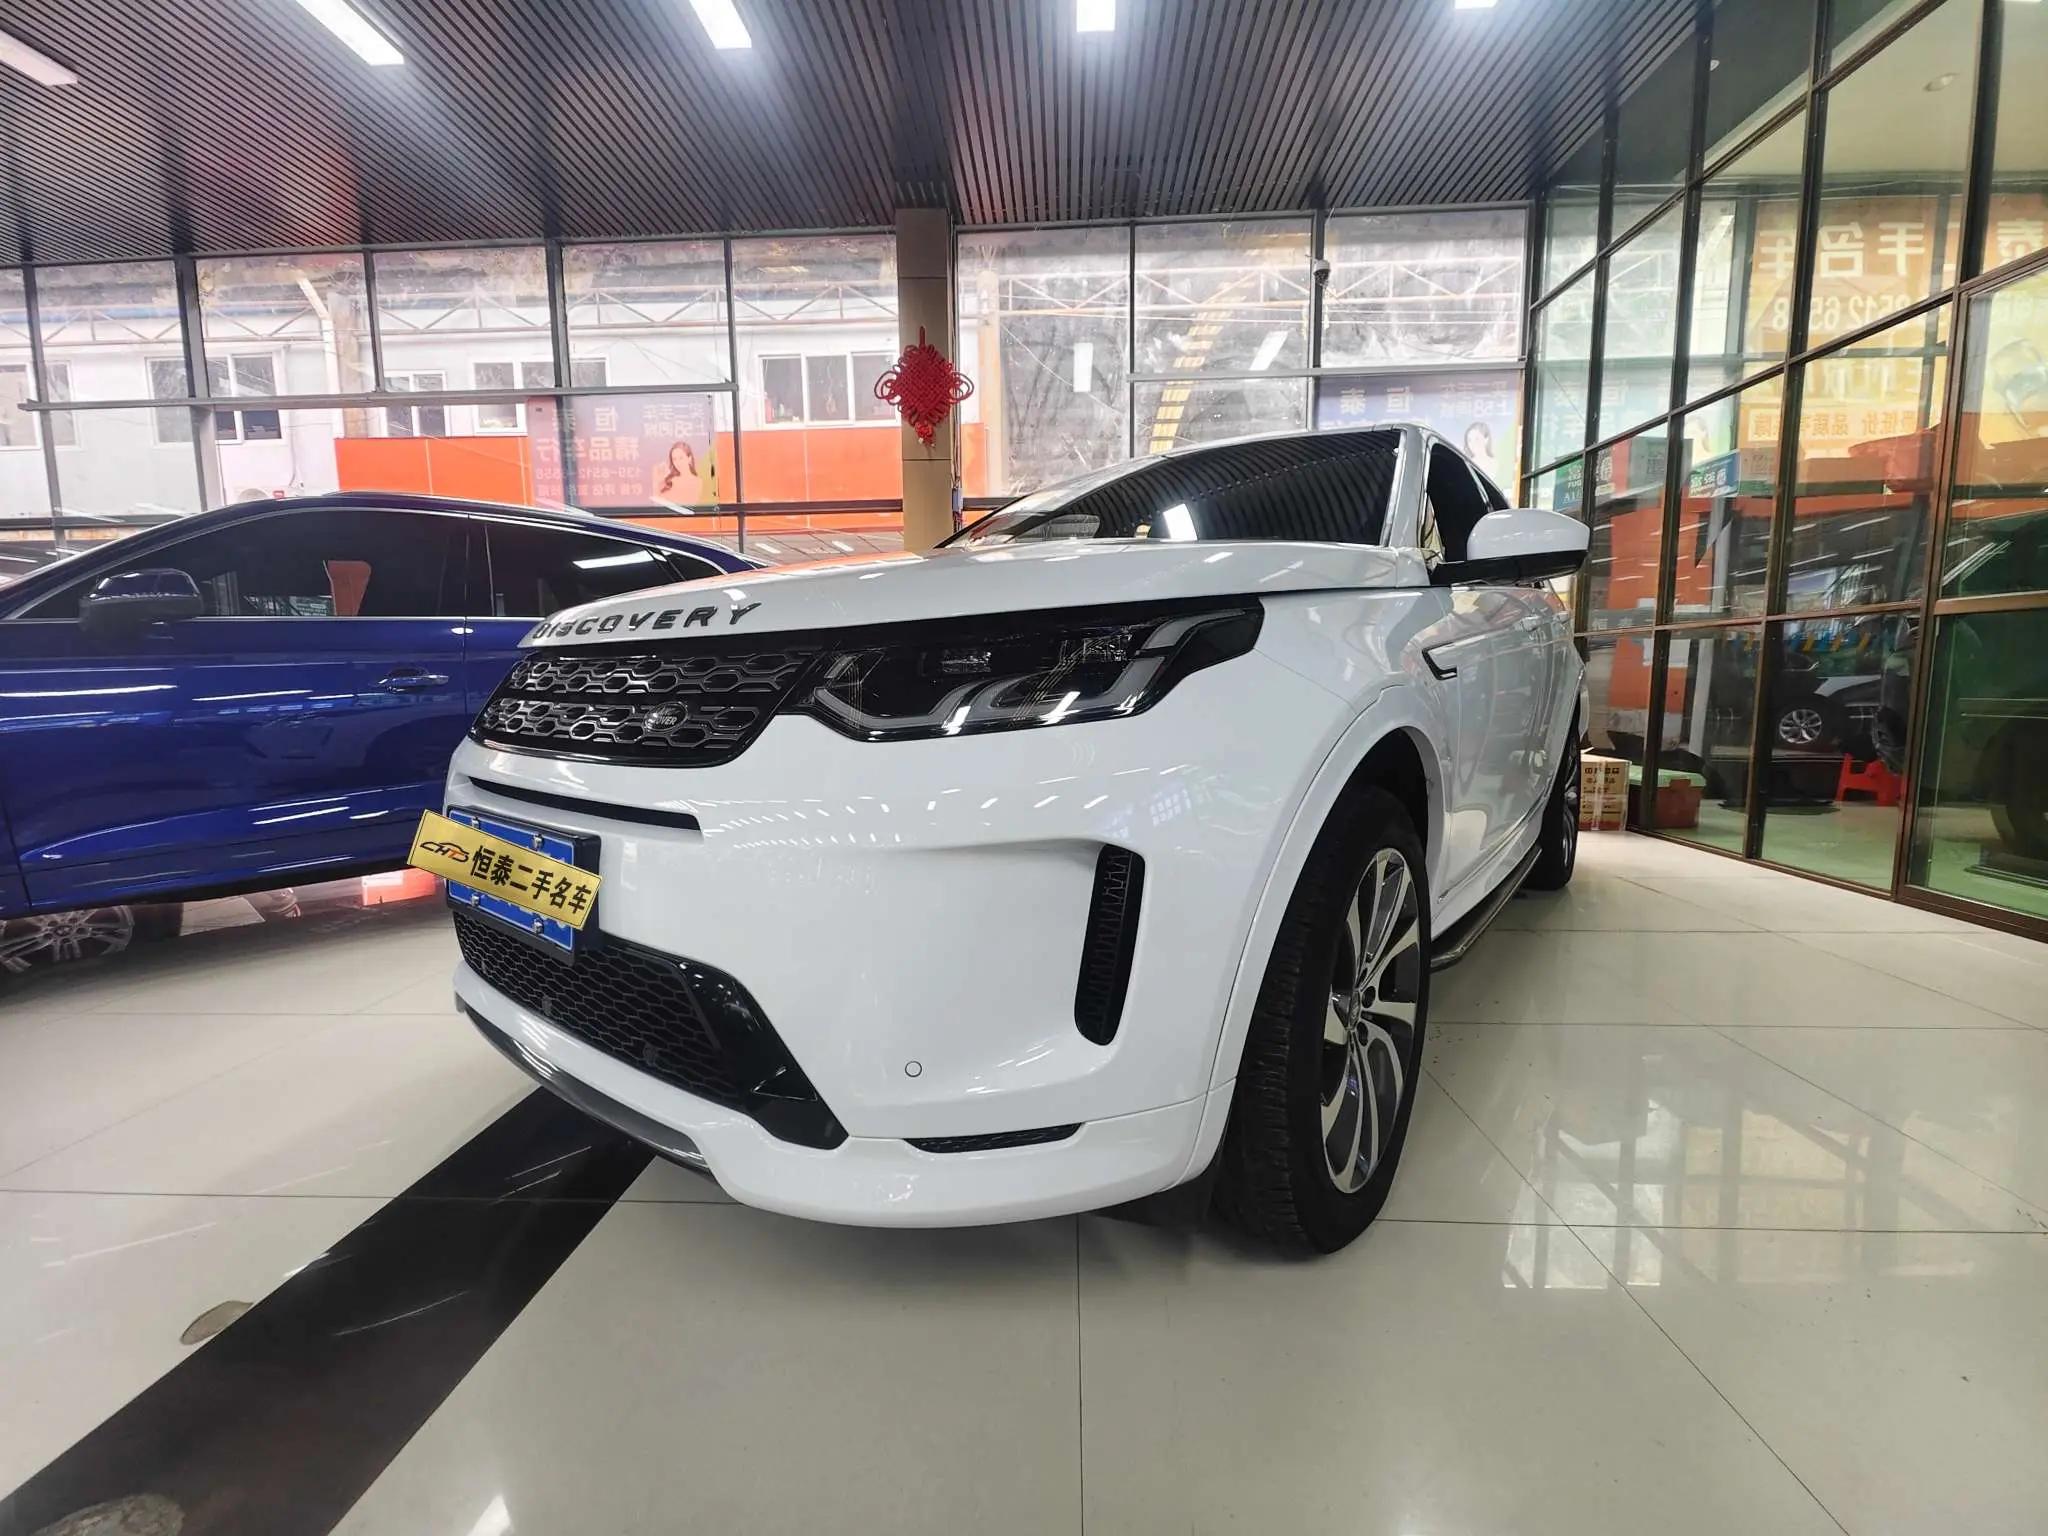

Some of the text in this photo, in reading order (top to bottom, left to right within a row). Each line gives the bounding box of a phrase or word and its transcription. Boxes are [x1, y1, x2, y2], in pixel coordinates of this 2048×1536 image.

[532, 602, 762, 640] DISCOVERY
[470, 845, 592, 915] 恒泰二手名车
